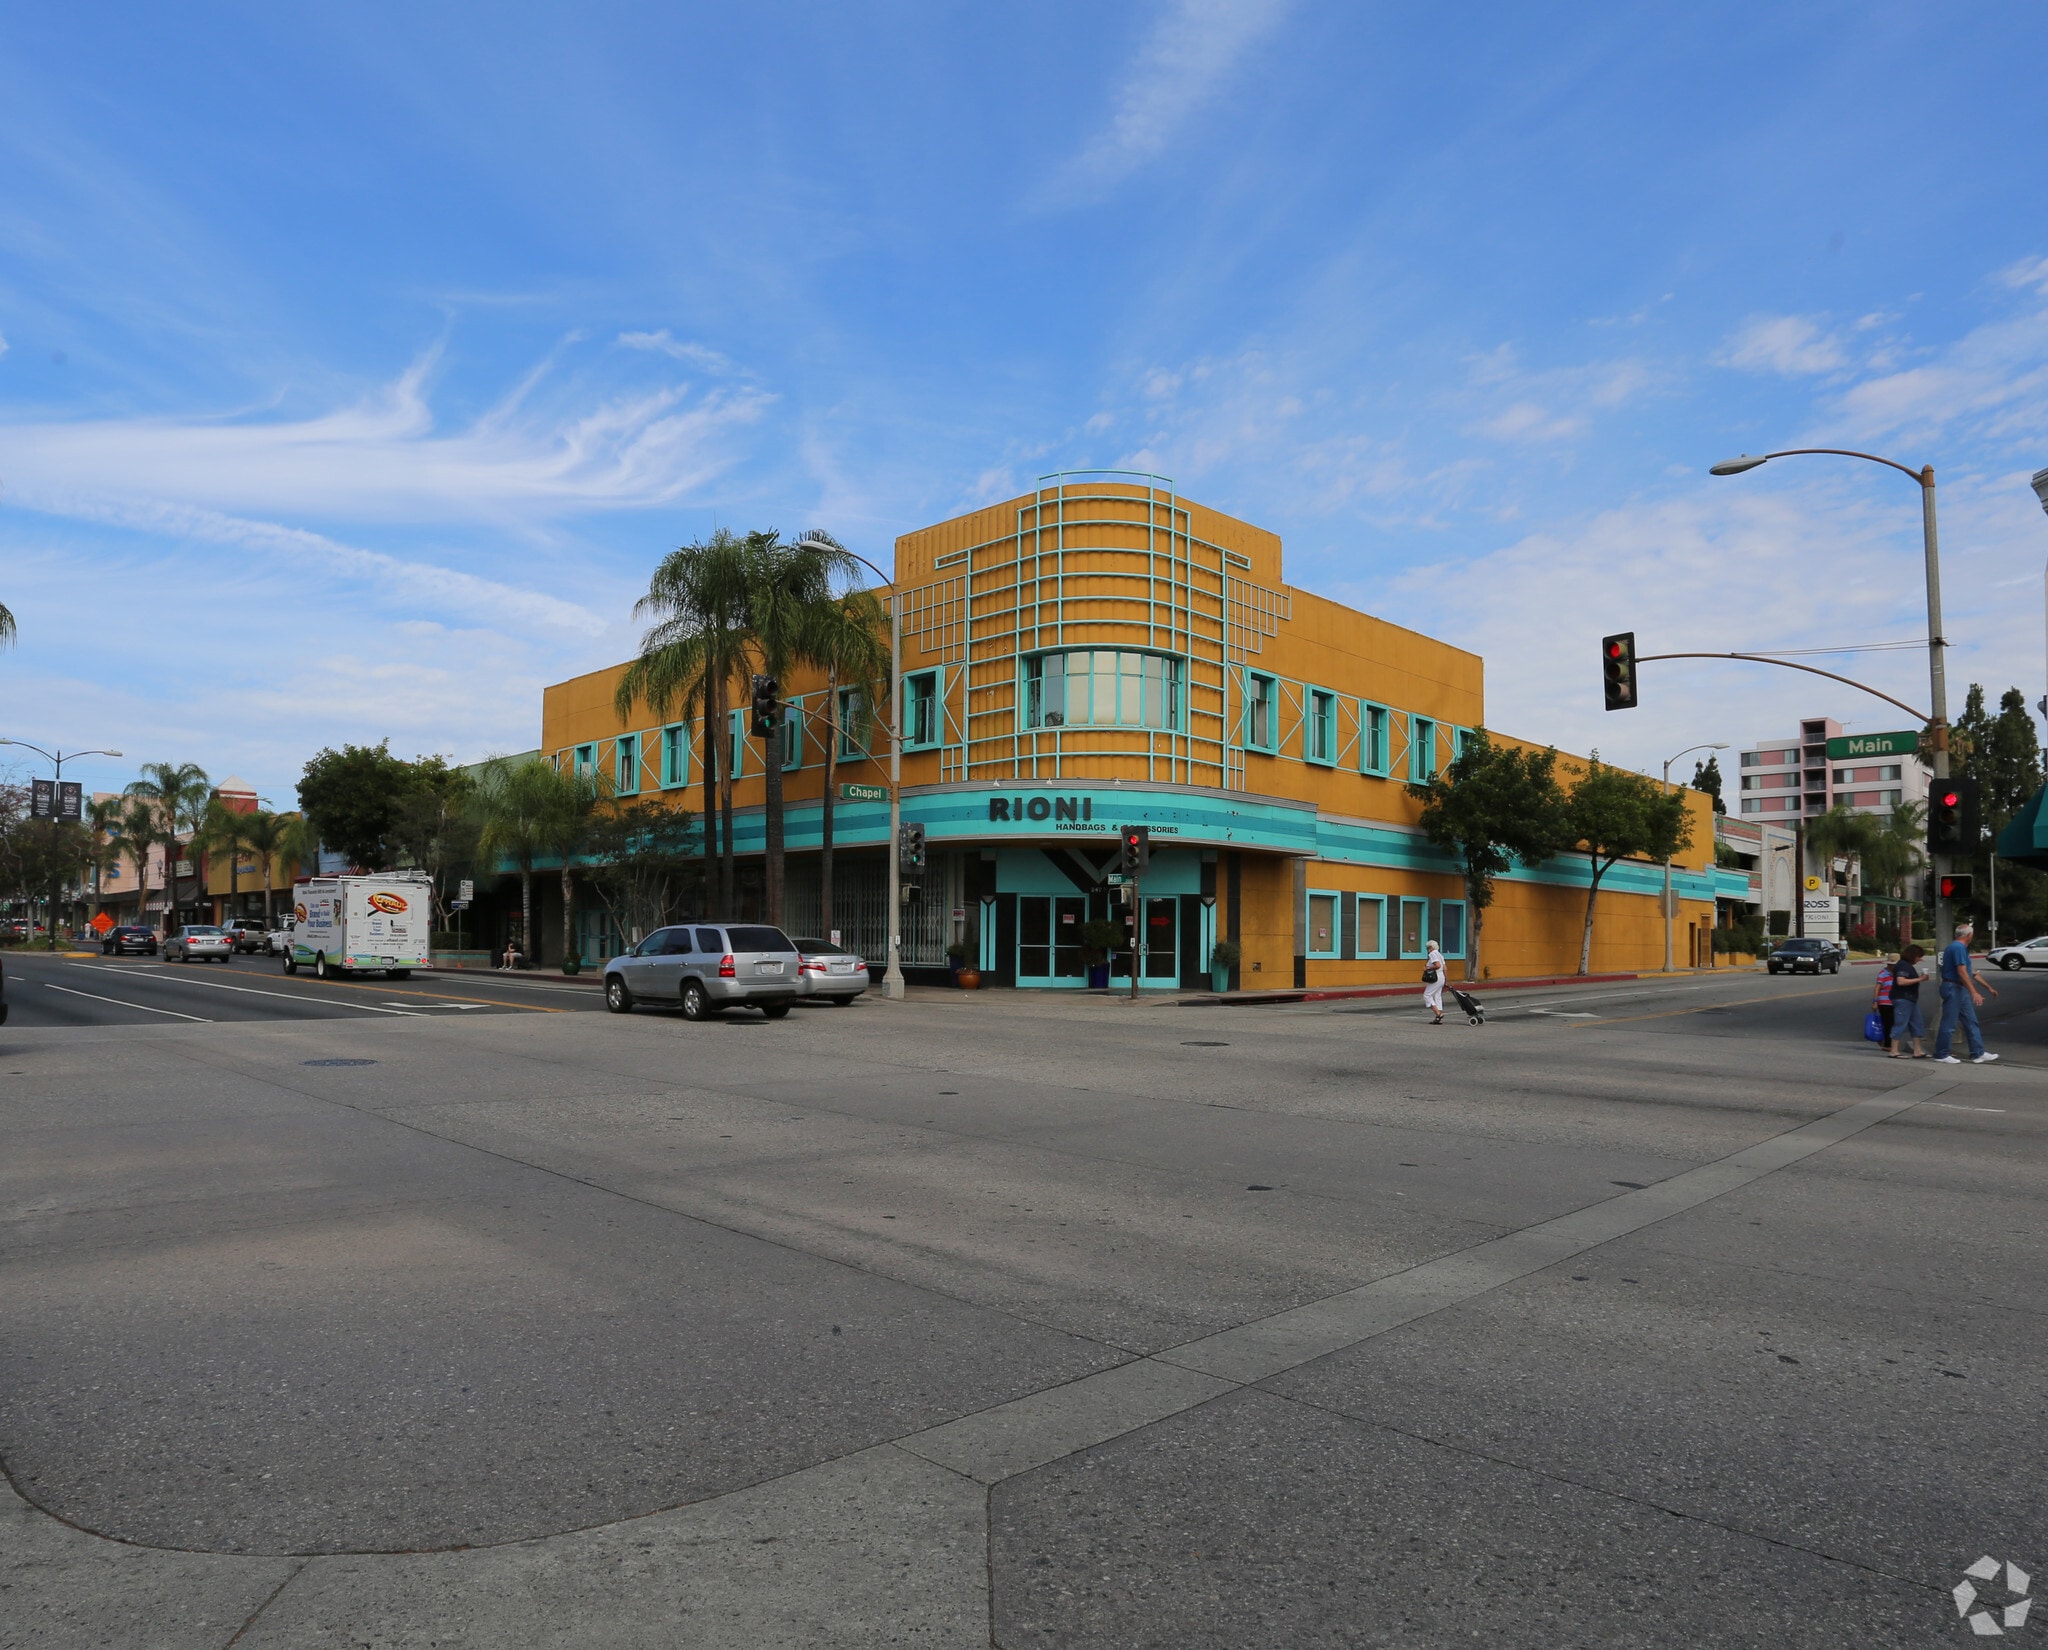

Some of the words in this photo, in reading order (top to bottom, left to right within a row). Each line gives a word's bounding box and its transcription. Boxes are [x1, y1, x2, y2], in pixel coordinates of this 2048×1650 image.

[1849, 738, 1893, 754] Main
[849, 785, 881, 799] Chapel
[989, 797, 1092, 821] RIONI
[1056, 823, 1105, 832] HANDBAGS
[1112, 824, 1118, 832] &
[1108, 874, 1122, 883] Main
[1809, 879, 1816, 887] P
